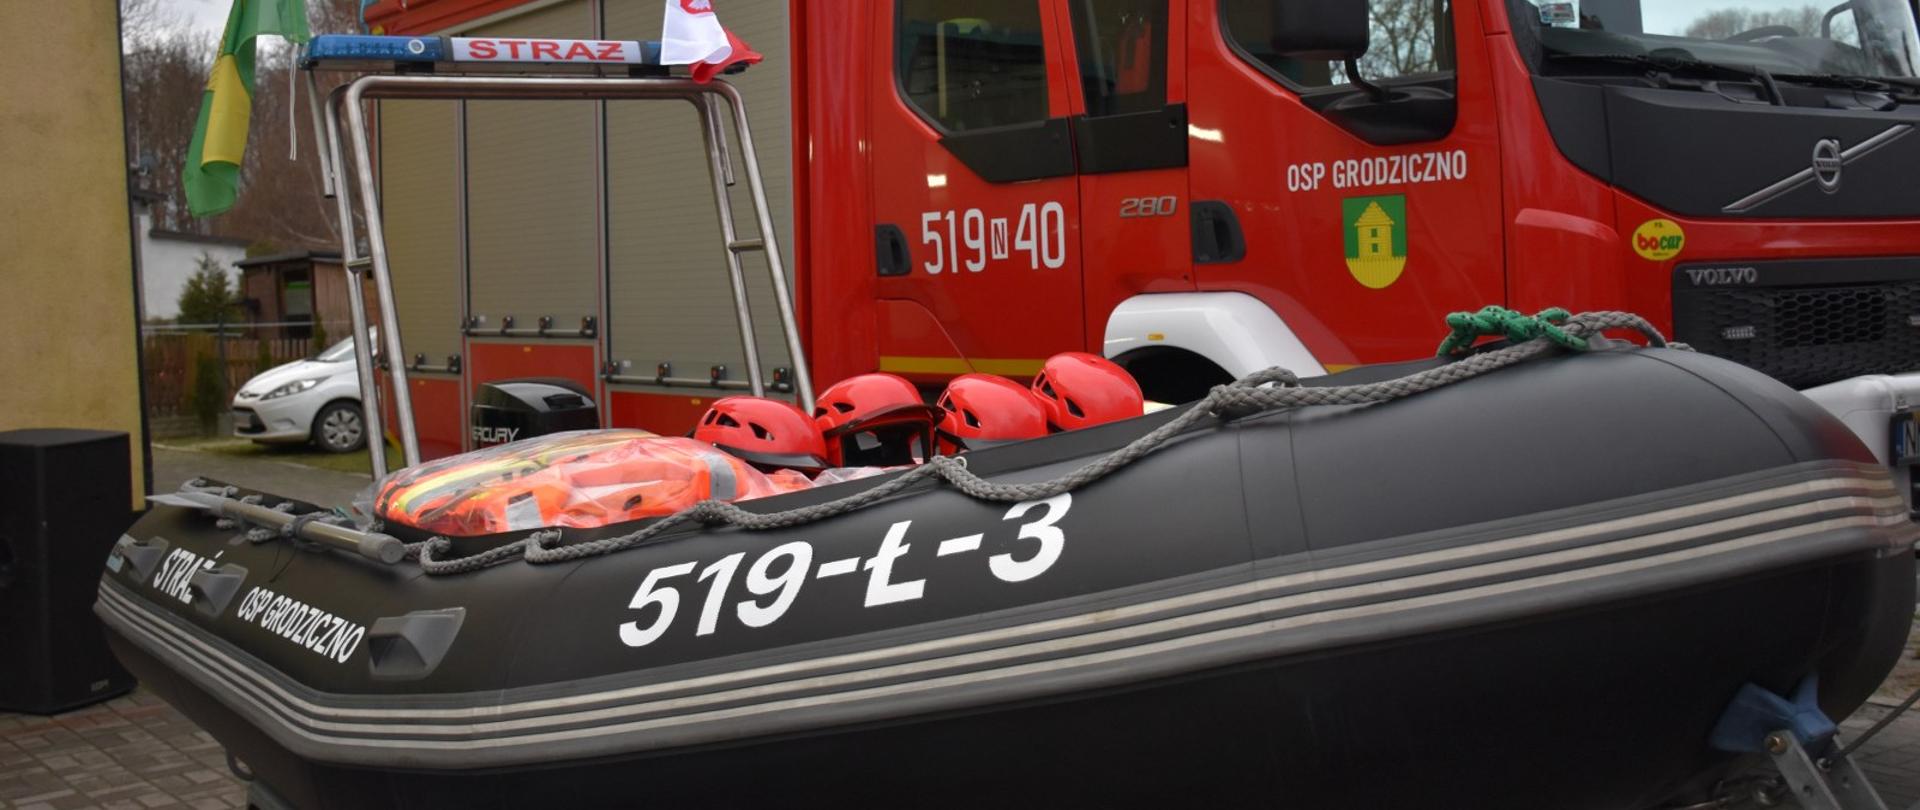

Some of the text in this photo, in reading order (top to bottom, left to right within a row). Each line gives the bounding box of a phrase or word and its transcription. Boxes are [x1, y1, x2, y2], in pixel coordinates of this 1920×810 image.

[1287, 150, 1467, 192] OSP GRODZICZNO
[1120, 195, 1177, 217] 280
[1686, 267, 1758, 286] VOLVO
[472, 427, 520, 443] ERCURY
[237, 586, 365, 664] OSP GRODZICZNO
